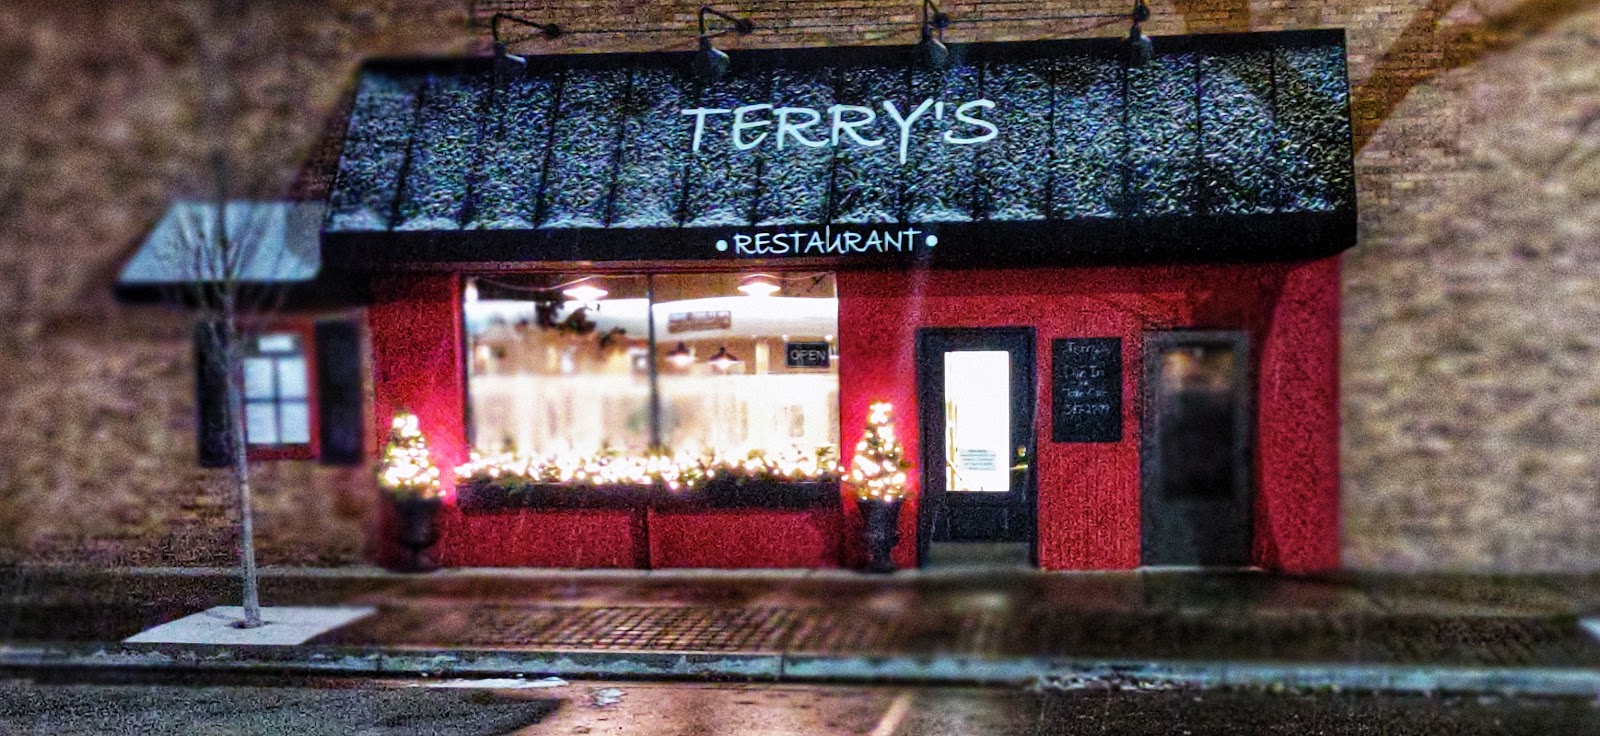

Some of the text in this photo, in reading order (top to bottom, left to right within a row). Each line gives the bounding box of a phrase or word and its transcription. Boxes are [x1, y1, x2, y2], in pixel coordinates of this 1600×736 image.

[681, 98, 999, 165] TERRY'S
[733, 225, 922, 255] RESTAURANT
[790, 349, 827, 362] OPEN
